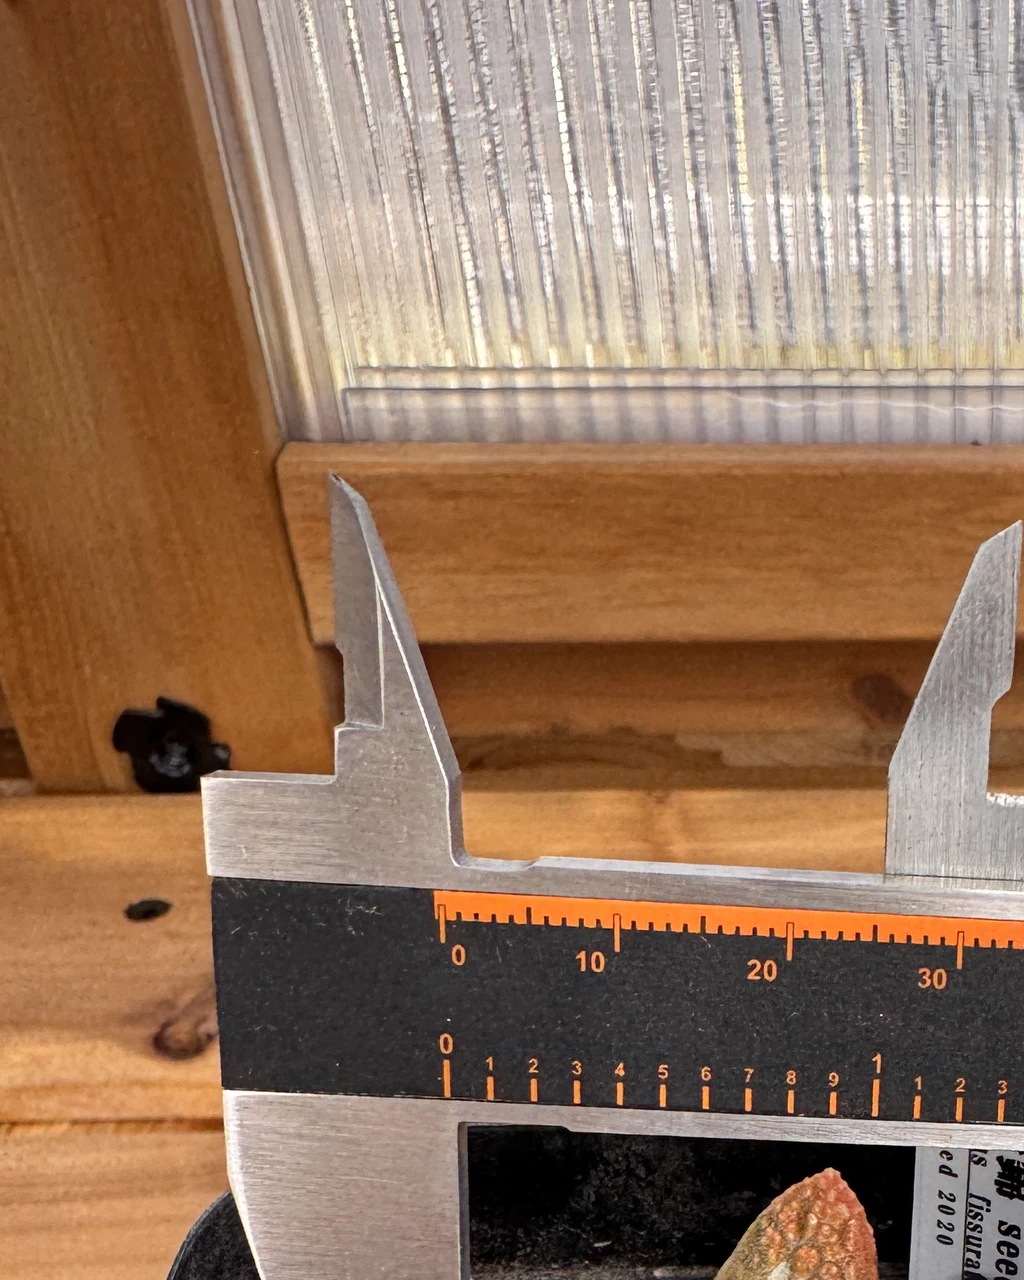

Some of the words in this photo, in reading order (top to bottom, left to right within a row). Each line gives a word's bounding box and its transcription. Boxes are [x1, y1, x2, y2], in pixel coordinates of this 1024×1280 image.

[451, 944, 466, 966] 0
[575, 950, 606, 973] 10
[746, 959, 778, 982] 20
[917, 967, 948, 990] 30
[439, 1033, 454, 1055] 0
[485, 1056, 494, 1071] 1
[528, 1058, 539, 1074] 2
[571, 1060, 582, 1075] 3
[614, 1062, 625, 1077] 4
[658, 1064, 669, 1080] 5
[700, 1066, 712, 1081] 6
[744, 1068, 754, 1083] 7
[786, 1070, 797, 1085] 8
[828, 1072, 839, 1087] 9
[871, 1052, 882, 1074] 1
[914, 1075, 923, 1091] 1
[955, 1077, 966, 1093] 2
[997, 1080, 1008, 1095] 3
[936, 1189, 956, 1245] 2020
[963, 1192, 991, 1278] fissura
